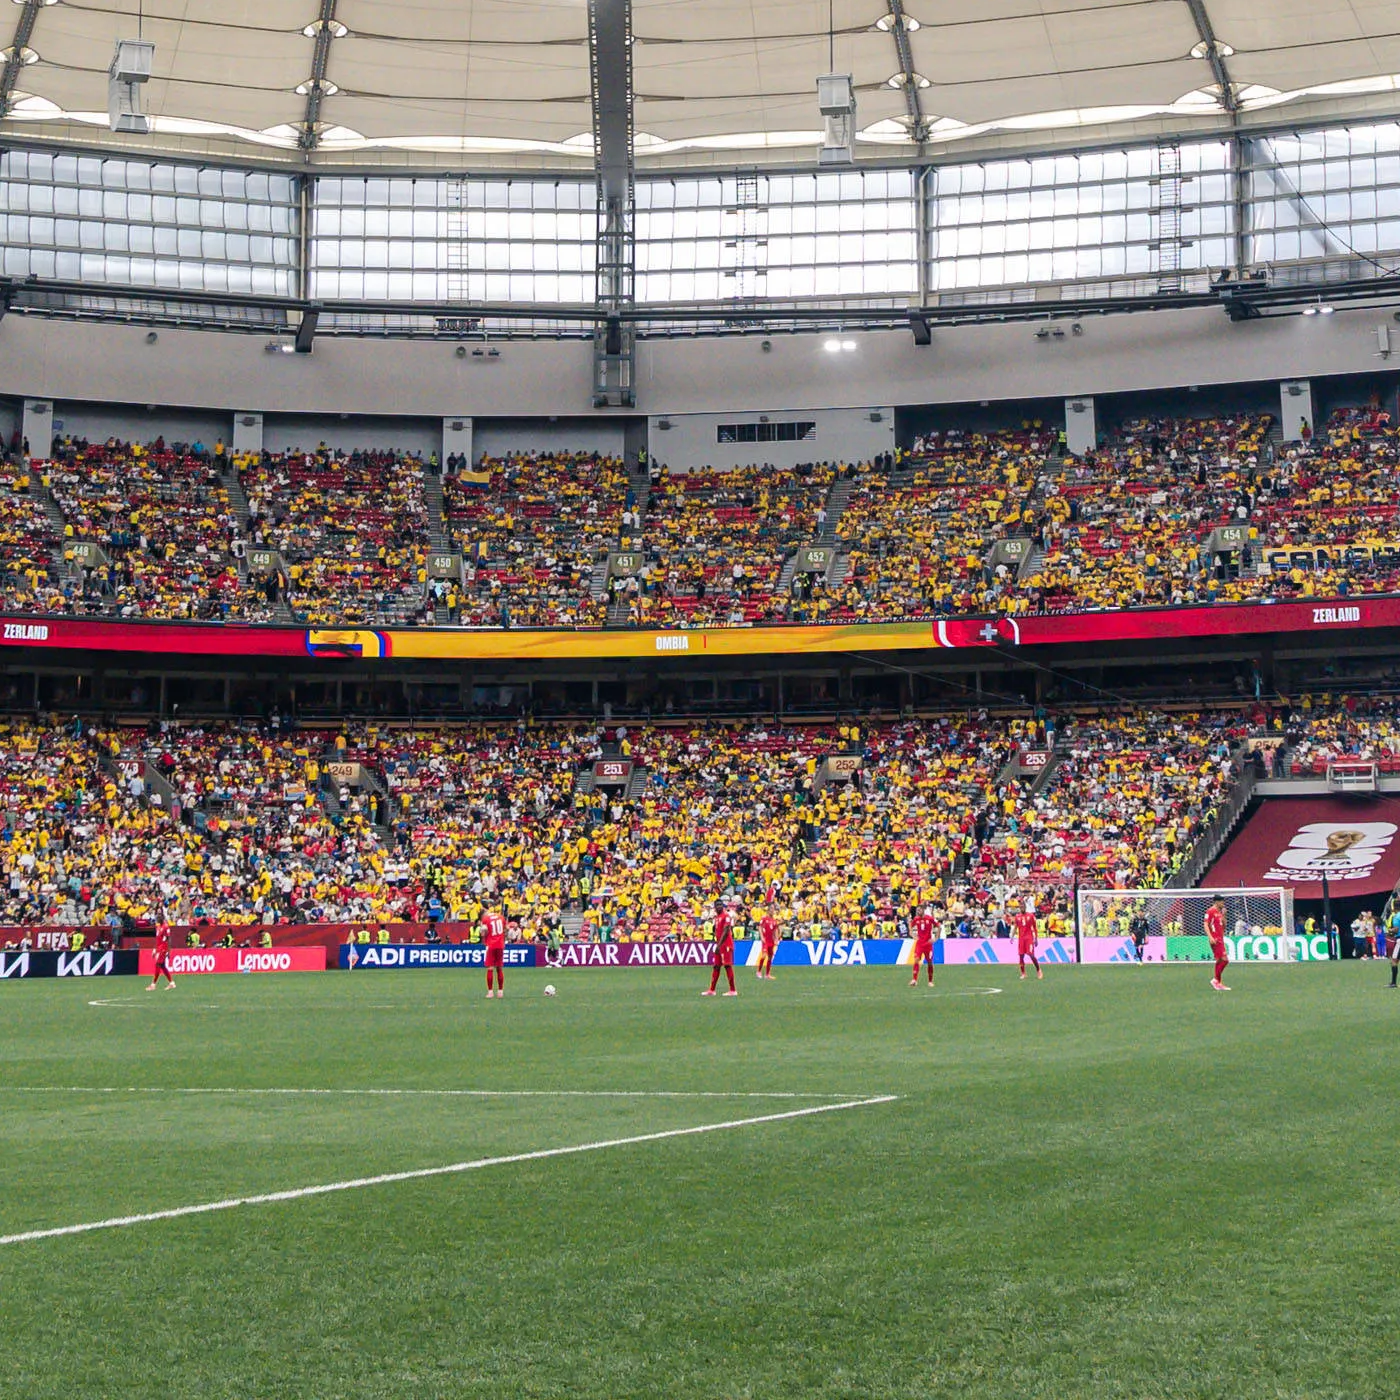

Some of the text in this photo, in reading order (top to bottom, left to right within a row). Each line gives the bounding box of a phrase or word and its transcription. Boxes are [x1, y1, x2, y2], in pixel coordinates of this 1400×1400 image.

[1223, 529, 1241, 541] 454
[1005, 542, 1022, 553] 453
[254, 553, 270, 565] 449
[435, 558, 451, 569] 450
[617, 556, 634, 567] 451
[808, 551, 825, 562] 452
[1312, 607, 1361, 624] ZERLAND
[3, 623, 49, 641] ZERLAND
[655, 636, 689, 650] OMBIA
[835, 760, 855, 771] 252
[1026, 754, 1047, 766] 253
[331, 765, 353, 776] 249
[603, 763, 624, 775] 251
[490, 919, 504, 936] 10
[37, 932, 70, 950] FIFA
[361, 948, 529, 965] ADI PREDICTSTEET
[544, 943, 620, 967] QATAR
[801, 940, 867, 964] VISA
[57, 951, 114, 976] KIA
[165, 954, 216, 974] Lenovo
[237, 951, 291, 971] Lenovo
